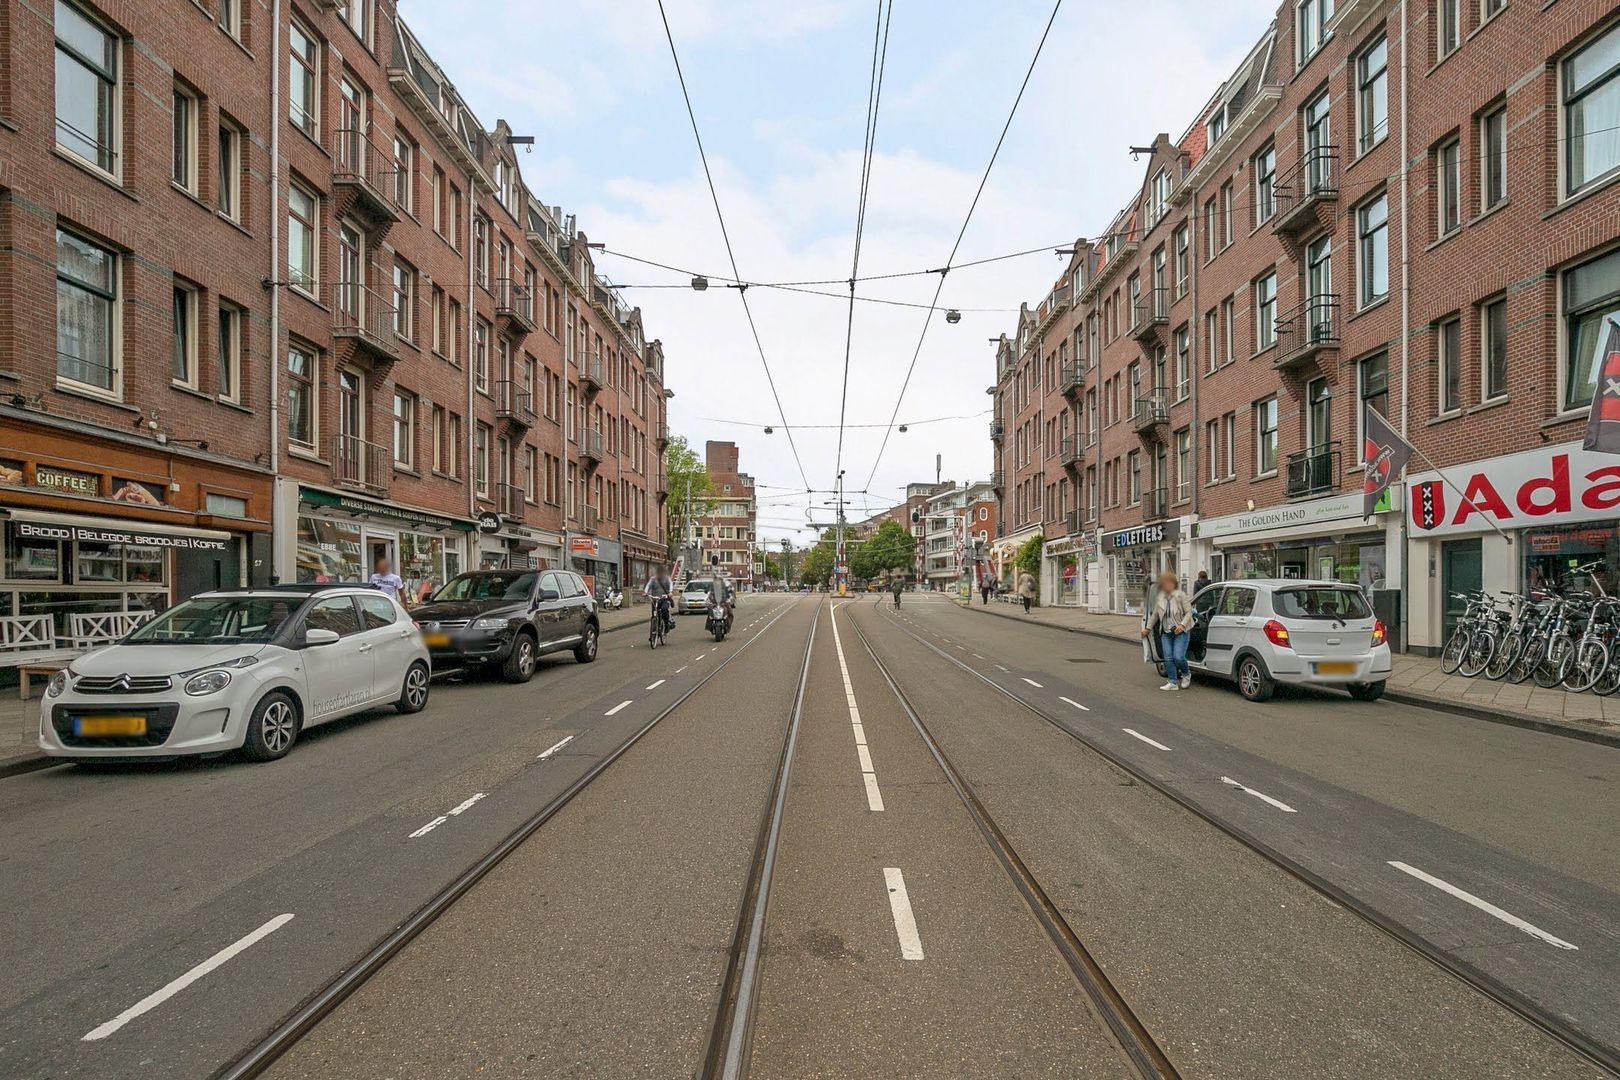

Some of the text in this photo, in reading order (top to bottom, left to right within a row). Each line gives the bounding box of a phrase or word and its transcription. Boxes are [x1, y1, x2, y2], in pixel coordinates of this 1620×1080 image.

[36, 472, 87, 490] COFFEE
[1239, 518, 1251, 529] THE
[1252, 513, 1280, 527] GOLDEN
[1282, 509, 1306, 521] HAND
[1112, 525, 1163, 547] LEDLETTERS
